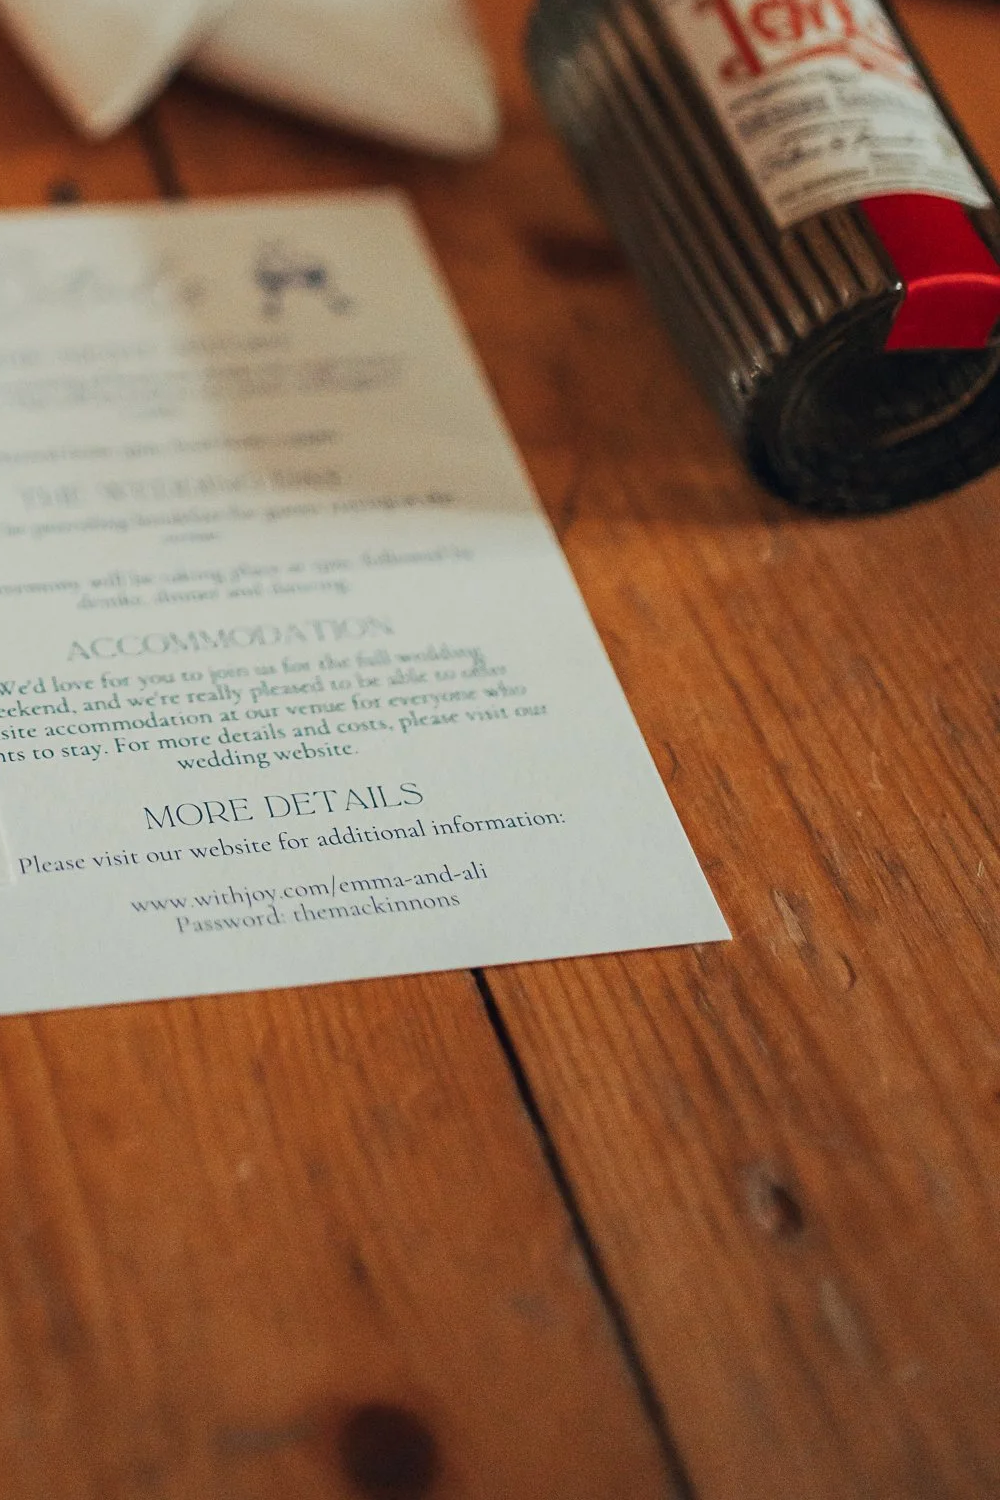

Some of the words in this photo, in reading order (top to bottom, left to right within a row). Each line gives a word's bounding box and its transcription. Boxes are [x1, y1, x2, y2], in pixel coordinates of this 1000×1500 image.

[66, 614, 396, 661] ACCOMMODATION
[51, 675, 95, 693] love
[101, 671, 131, 689] for
[136, 671, 175, 691] you
[181, 669, 202, 684] to
[208, 664, 249, 685] join
[253, 663, 278, 676] us
[281, 655, 310, 676] for
[317, 652, 350, 672] the
[355, 647, 392, 668] full
[394, 642, 486, 668] wedding
[83, 693, 122, 712] and
[126, 690, 180, 708] we're
[186, 682, 242, 705] really
[250, 675, 325, 703] pleased
[330, 676, 351, 692] to
[356, 671, 381, 689] be
[386, 667, 428, 686] able
[434, 665, 457, 682] to
[33, 746, 55, 760] to
[61, 743, 109, 764] stay.
[113, 736, 152, 754] For
[157, 733, 212, 750] more
[217, 723, 287, 745] details
[293, 717, 333, 738] and
[336, 717, 394, 735] costs,
[398, 710, 460, 734] please
[465, 705, 509, 722] visit
[514, 703, 548, 718] our
[45, 712, 213, 737] accommodation
[219, 709, 240, 723] at
[245, 706, 280, 720] our
[285, 700, 347, 716] venue
[351, 693, 382, 710] for
[387, 688, 478, 709] everyone
[177, 747, 271, 770] wedding
[274, 741, 360, 762] website.
[143, 798, 254, 830] MORE
[264, 782, 424, 818] DETAILS
[18, 855, 86, 875] Please
[92, 850, 140, 868] visit
[146, 849, 183, 864] our
[188, 838, 272, 859] website
[278, 831, 309, 851] for
[317, 819, 427, 848] additional
[431, 811, 566, 836] information:
[130, 861, 489, 913] www.withjoy.com/emma-and-ali
[175, 903, 286, 934] Password:
[293, 893, 461, 924] themackinnons
